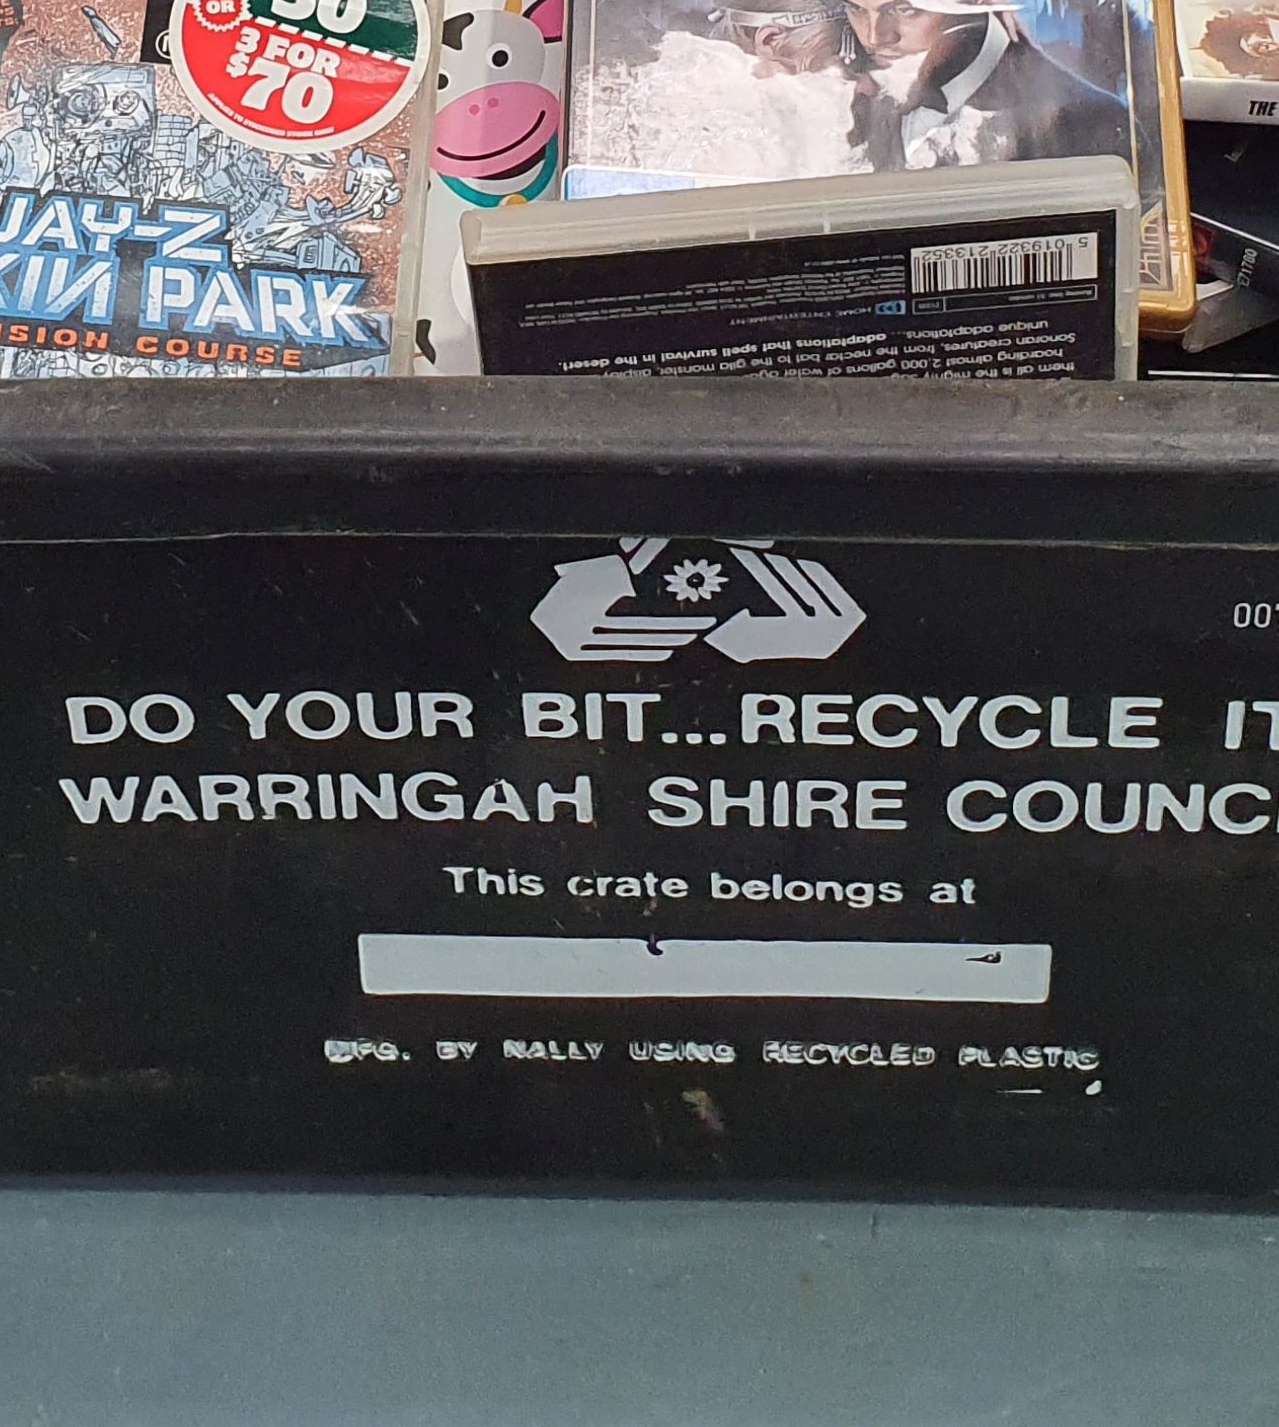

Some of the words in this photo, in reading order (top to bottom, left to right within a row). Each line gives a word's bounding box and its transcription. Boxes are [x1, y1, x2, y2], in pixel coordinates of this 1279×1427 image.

[234, 25, 261, 55] 3
[263, 33, 342, 79] FOR
[225, 52, 335, 125] $70
[1247, 99, 1277, 118] THE
[998, 237, 1065, 255] 019322
[1077, 236, 1089, 248] 5
[920, 245, 989, 262] 213352
[147, 265, 368, 342] PARK
[997, 318, 1049, 333] unique
[761, 340, 791, 353] that
[796, 331, 887, 351] adaptations
[940, 336, 1012, 353] creatures,
[1015, 331, 1076, 347] Sonoran
[135, 335, 304, 367] COURSE
[660, 347, 717, 362] survival
[722, 342, 757, 357] spell
[825, 348, 872, 361] nectar
[874, 346, 898, 358] the
[902, 343, 935, 356] from
[997, 346, 1063, 363] hoarding
[558, 357, 610, 371] desert.
[614, 355, 637, 366] the
[641, 353, 656, 364] in
[750, 356, 773, 368] the
[777, 354, 791, 365] to
[795, 351, 820, 364] bat
[946, 353, 993, 367] almost
[784, 366, 823, 380] water
[827, 365, 842, 376] of
[845, 359, 897, 375] gallons
[974, 368, 998, 379] the
[1002, 366, 1013, 376] is
[1016, 364, 1034, 375] all
[1038, 361, 1075, 374] them
[64, 692, 196, 745] DO
[226, 689, 475, 740] YOUR
[58, 771, 595, 826] WARRINGAH
[647, 775, 909, 831] SHIRE
[441, 865, 546, 898] This
[565, 869, 689, 899] crate
[710, 872, 904, 910] belongs
[928, 876, 978, 905] at
[435, 1039, 480, 1062] BY
[501, 1037, 606, 1062] NALLY
[627, 1038, 737, 1064] USING
[761, 1039, 937, 1068] RECYCLED
[957, 1042, 1102, 1071] PLASTIC
